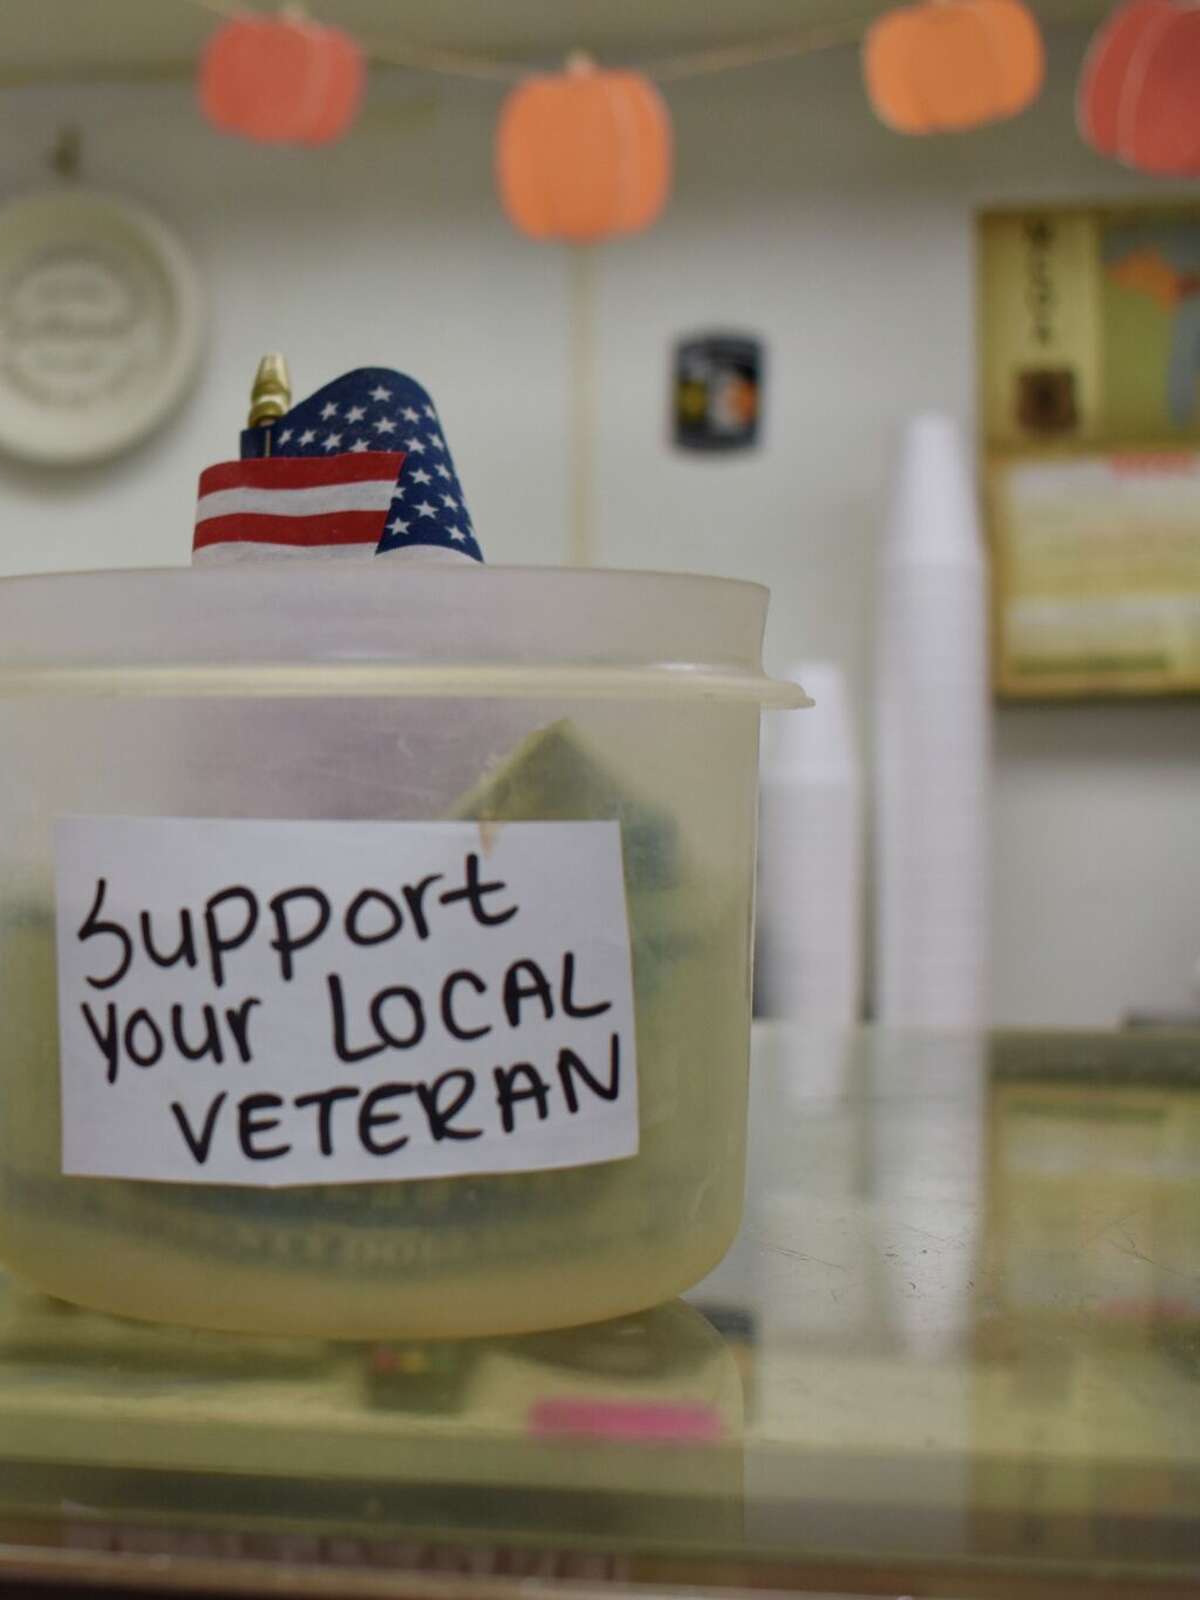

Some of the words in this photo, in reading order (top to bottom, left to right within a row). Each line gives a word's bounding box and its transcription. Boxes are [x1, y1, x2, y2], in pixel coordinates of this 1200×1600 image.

[78, 853, 519, 989] Support
[80, 997, 262, 1084] your
[327, 951, 613, 1063] LOCAL
[171, 1032, 621, 1164] VETERAN
